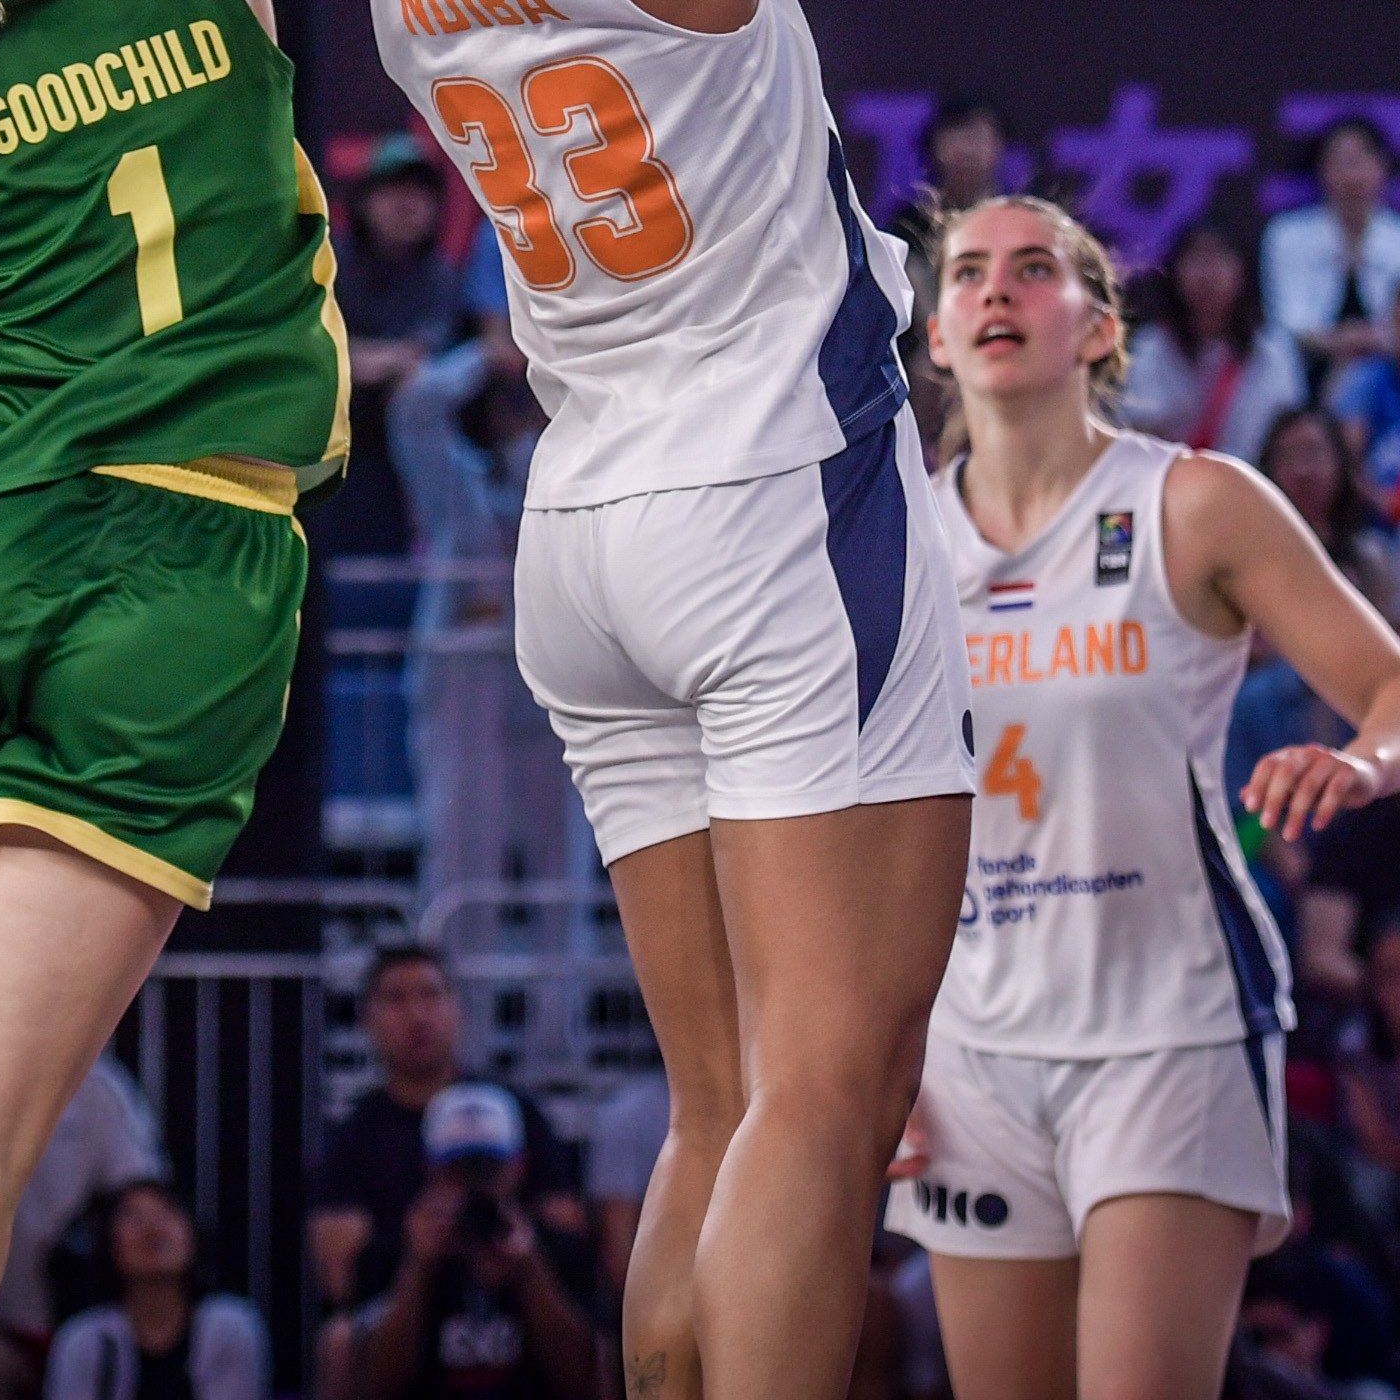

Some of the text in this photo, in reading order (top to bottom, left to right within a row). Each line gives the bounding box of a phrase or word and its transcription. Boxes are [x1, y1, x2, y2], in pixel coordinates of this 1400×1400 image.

[106, 143, 185, 338] 1
[430, 54, 695, 293] 33
[983, 723, 1042, 821] 4
